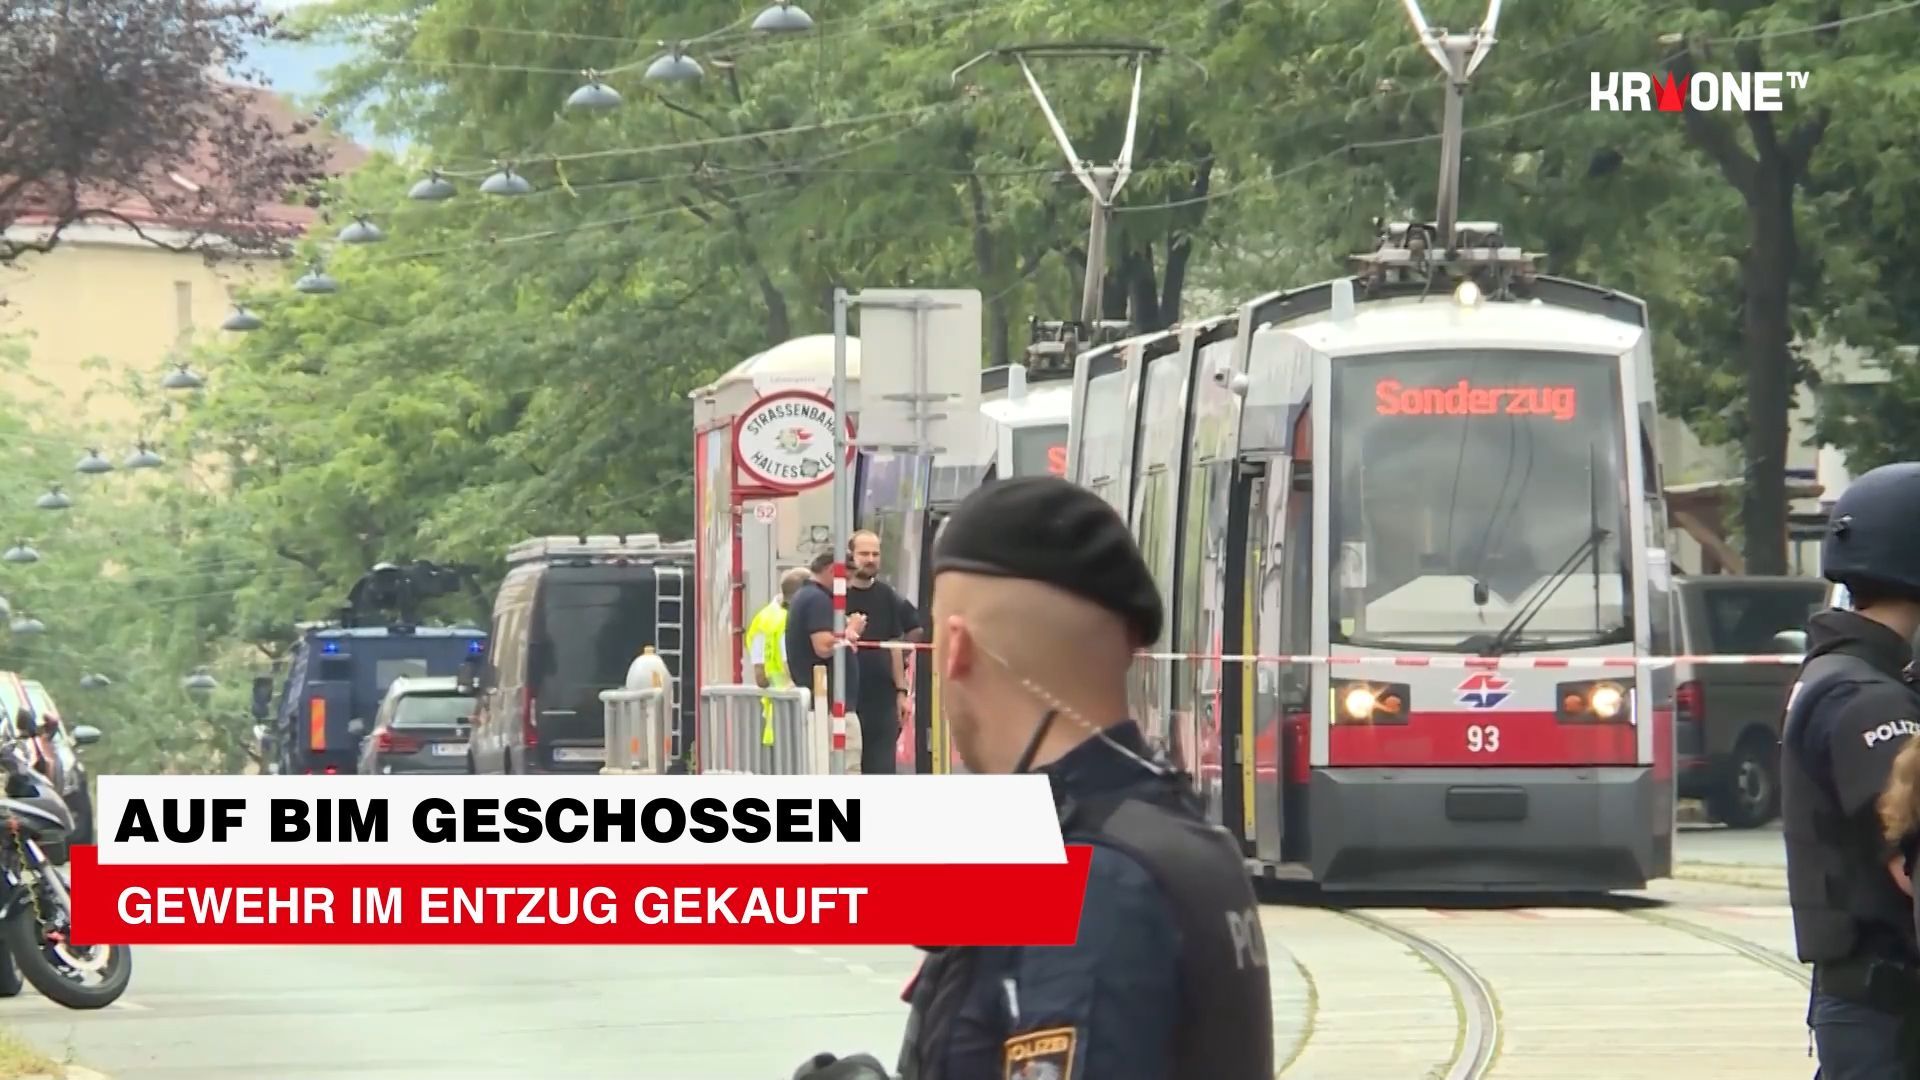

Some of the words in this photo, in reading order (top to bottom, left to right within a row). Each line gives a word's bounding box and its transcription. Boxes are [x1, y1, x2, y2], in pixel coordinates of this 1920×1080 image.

[1376, 379, 1576, 420] Sonderzug
[756, 505, 774, 518] 52
[1467, 724, 1500, 752] 93
